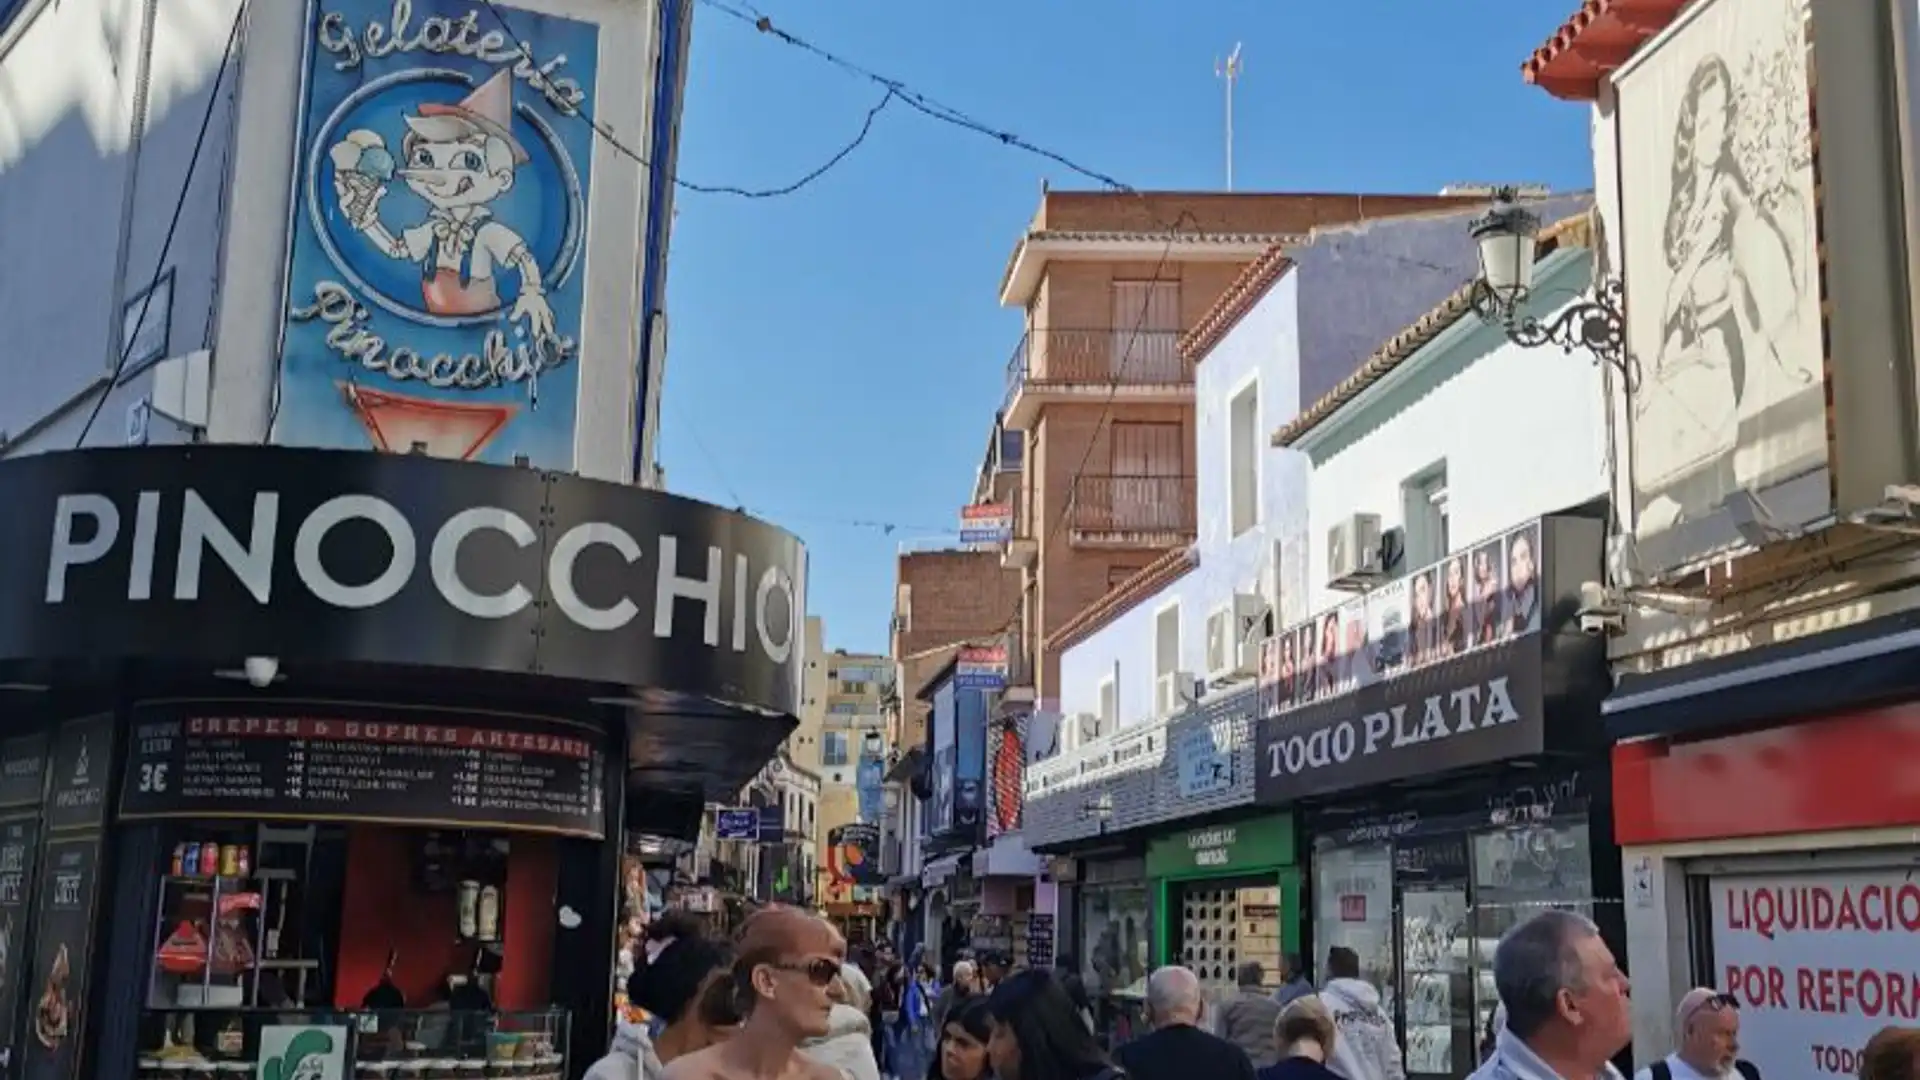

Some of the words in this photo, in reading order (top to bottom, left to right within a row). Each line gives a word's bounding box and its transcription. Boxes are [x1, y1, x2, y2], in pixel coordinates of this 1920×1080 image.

[45, 490, 794, 664] PINOCCHIO
[190, 717, 299, 734] CREPES
[346, 721, 457, 742] GOFRES
[1363, 676, 1519, 755] PLATA
[139, 764, 168, 792] 3€
[1725, 964, 1789, 1010] POR
